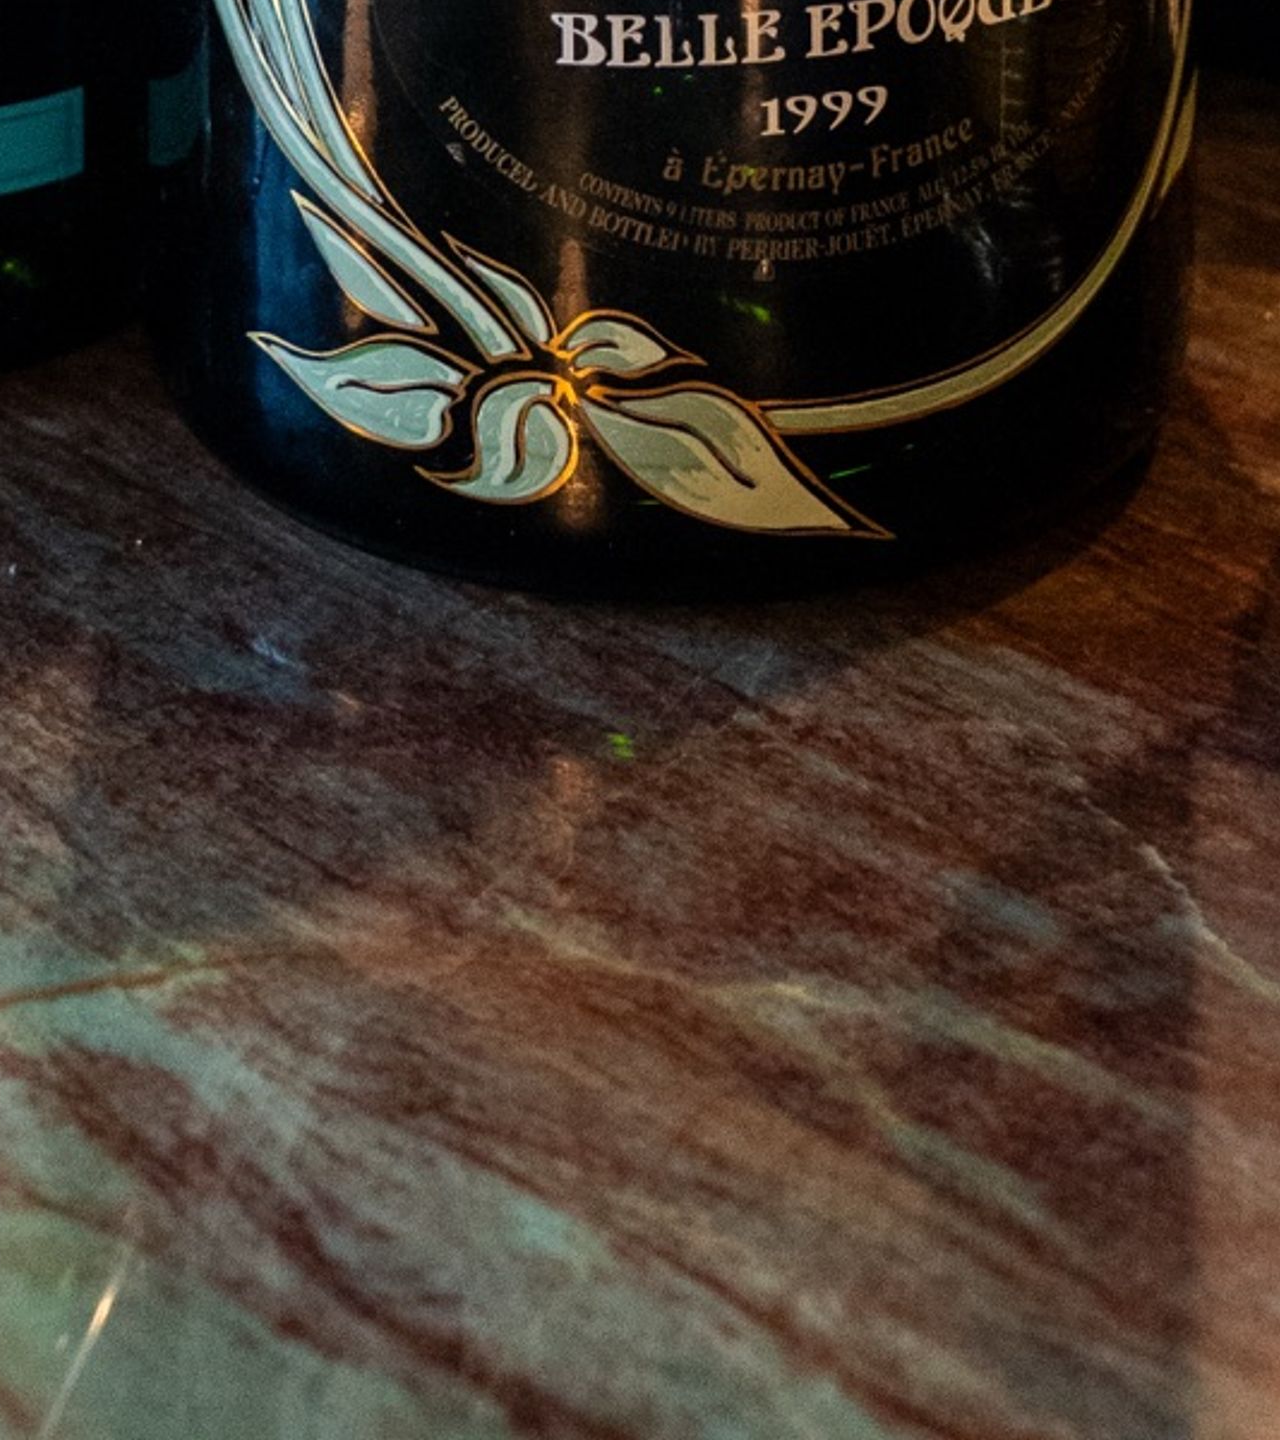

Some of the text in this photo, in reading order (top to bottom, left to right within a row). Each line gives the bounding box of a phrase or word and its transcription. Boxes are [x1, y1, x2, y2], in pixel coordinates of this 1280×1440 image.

[551, 10, 788, 70] BELLE
[760, 84, 889, 138] 1999
[661, 144, 684, 182] à
[538, 182, 589, 220] AND
[579, 172, 664, 217] CONTENTS
[744, 208, 821, 233] PRODUCT
[824, 206, 846, 228] OF
[850, 191, 911, 224] FRANCE
